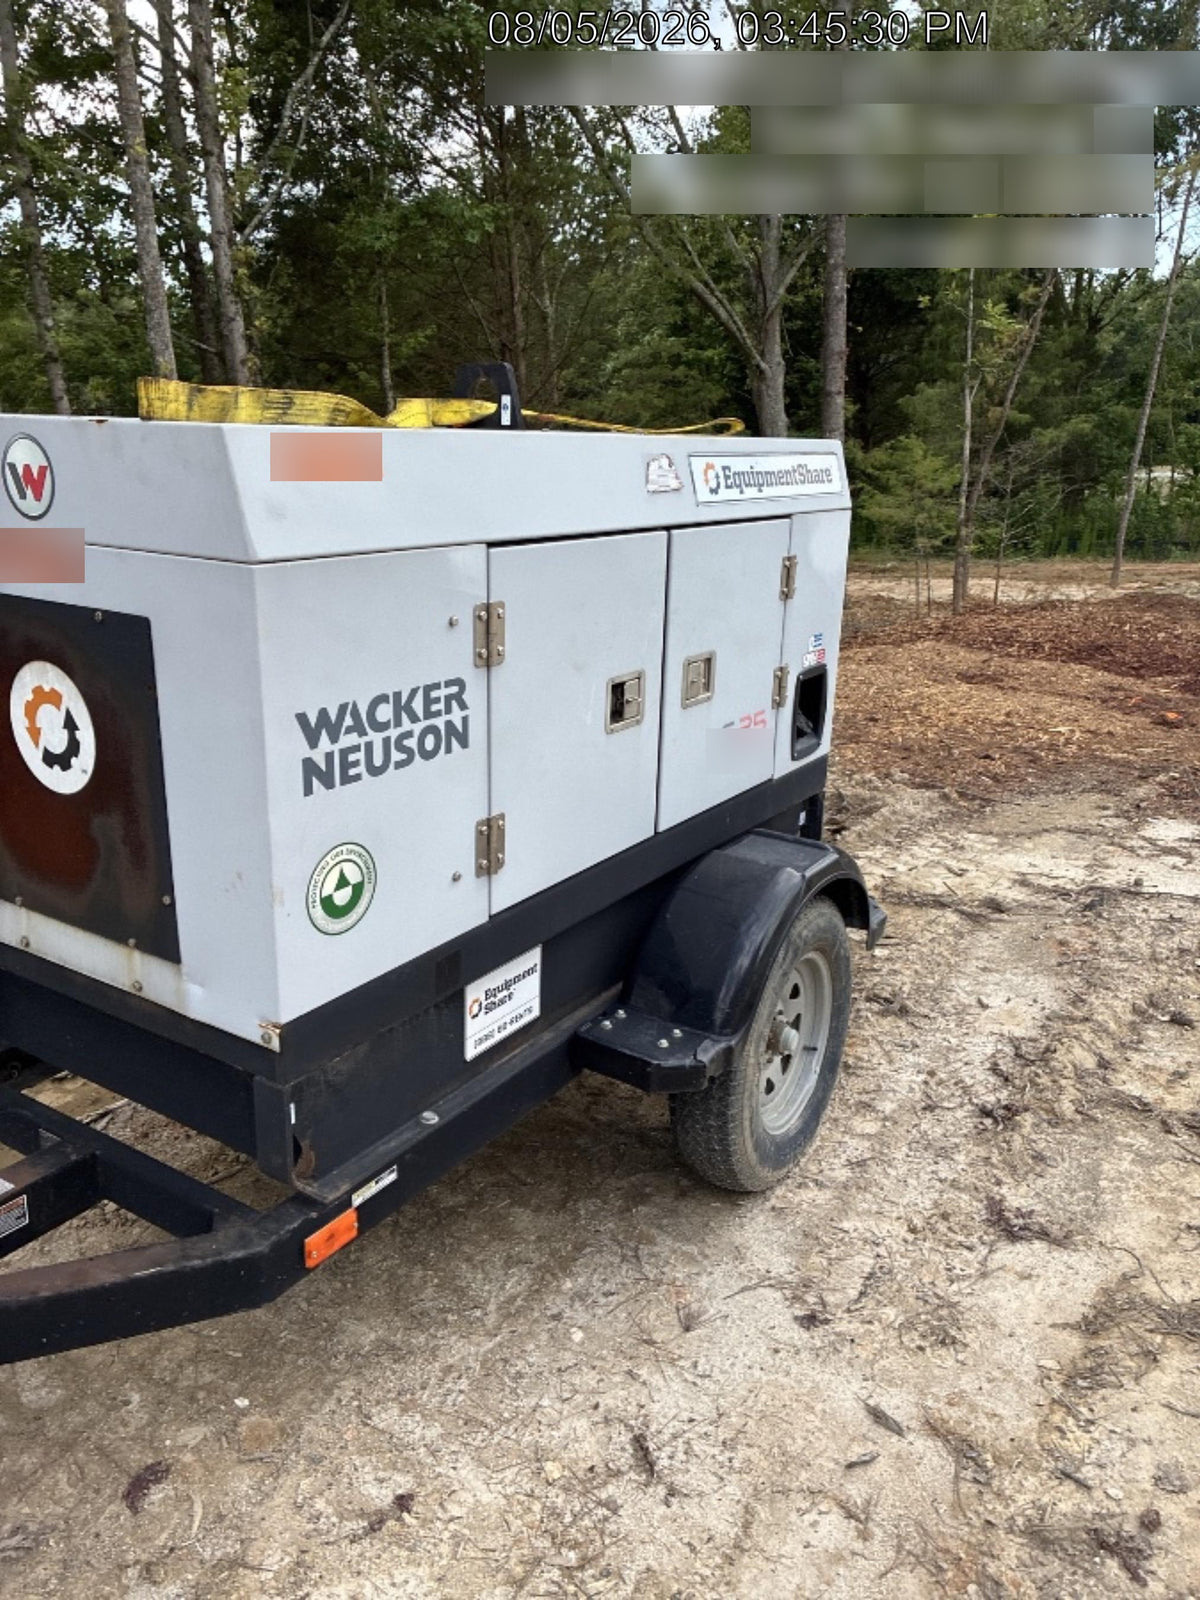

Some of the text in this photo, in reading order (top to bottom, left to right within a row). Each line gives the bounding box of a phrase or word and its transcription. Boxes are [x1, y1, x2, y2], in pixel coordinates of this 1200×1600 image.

[721, 463, 833, 495] EquipmentShare
[295, 677, 470, 750] WACKER
[302, 714, 470, 797] NEUSON
[484, 963, 538, 1001] Equipment
[484, 991, 514, 1015] Share
